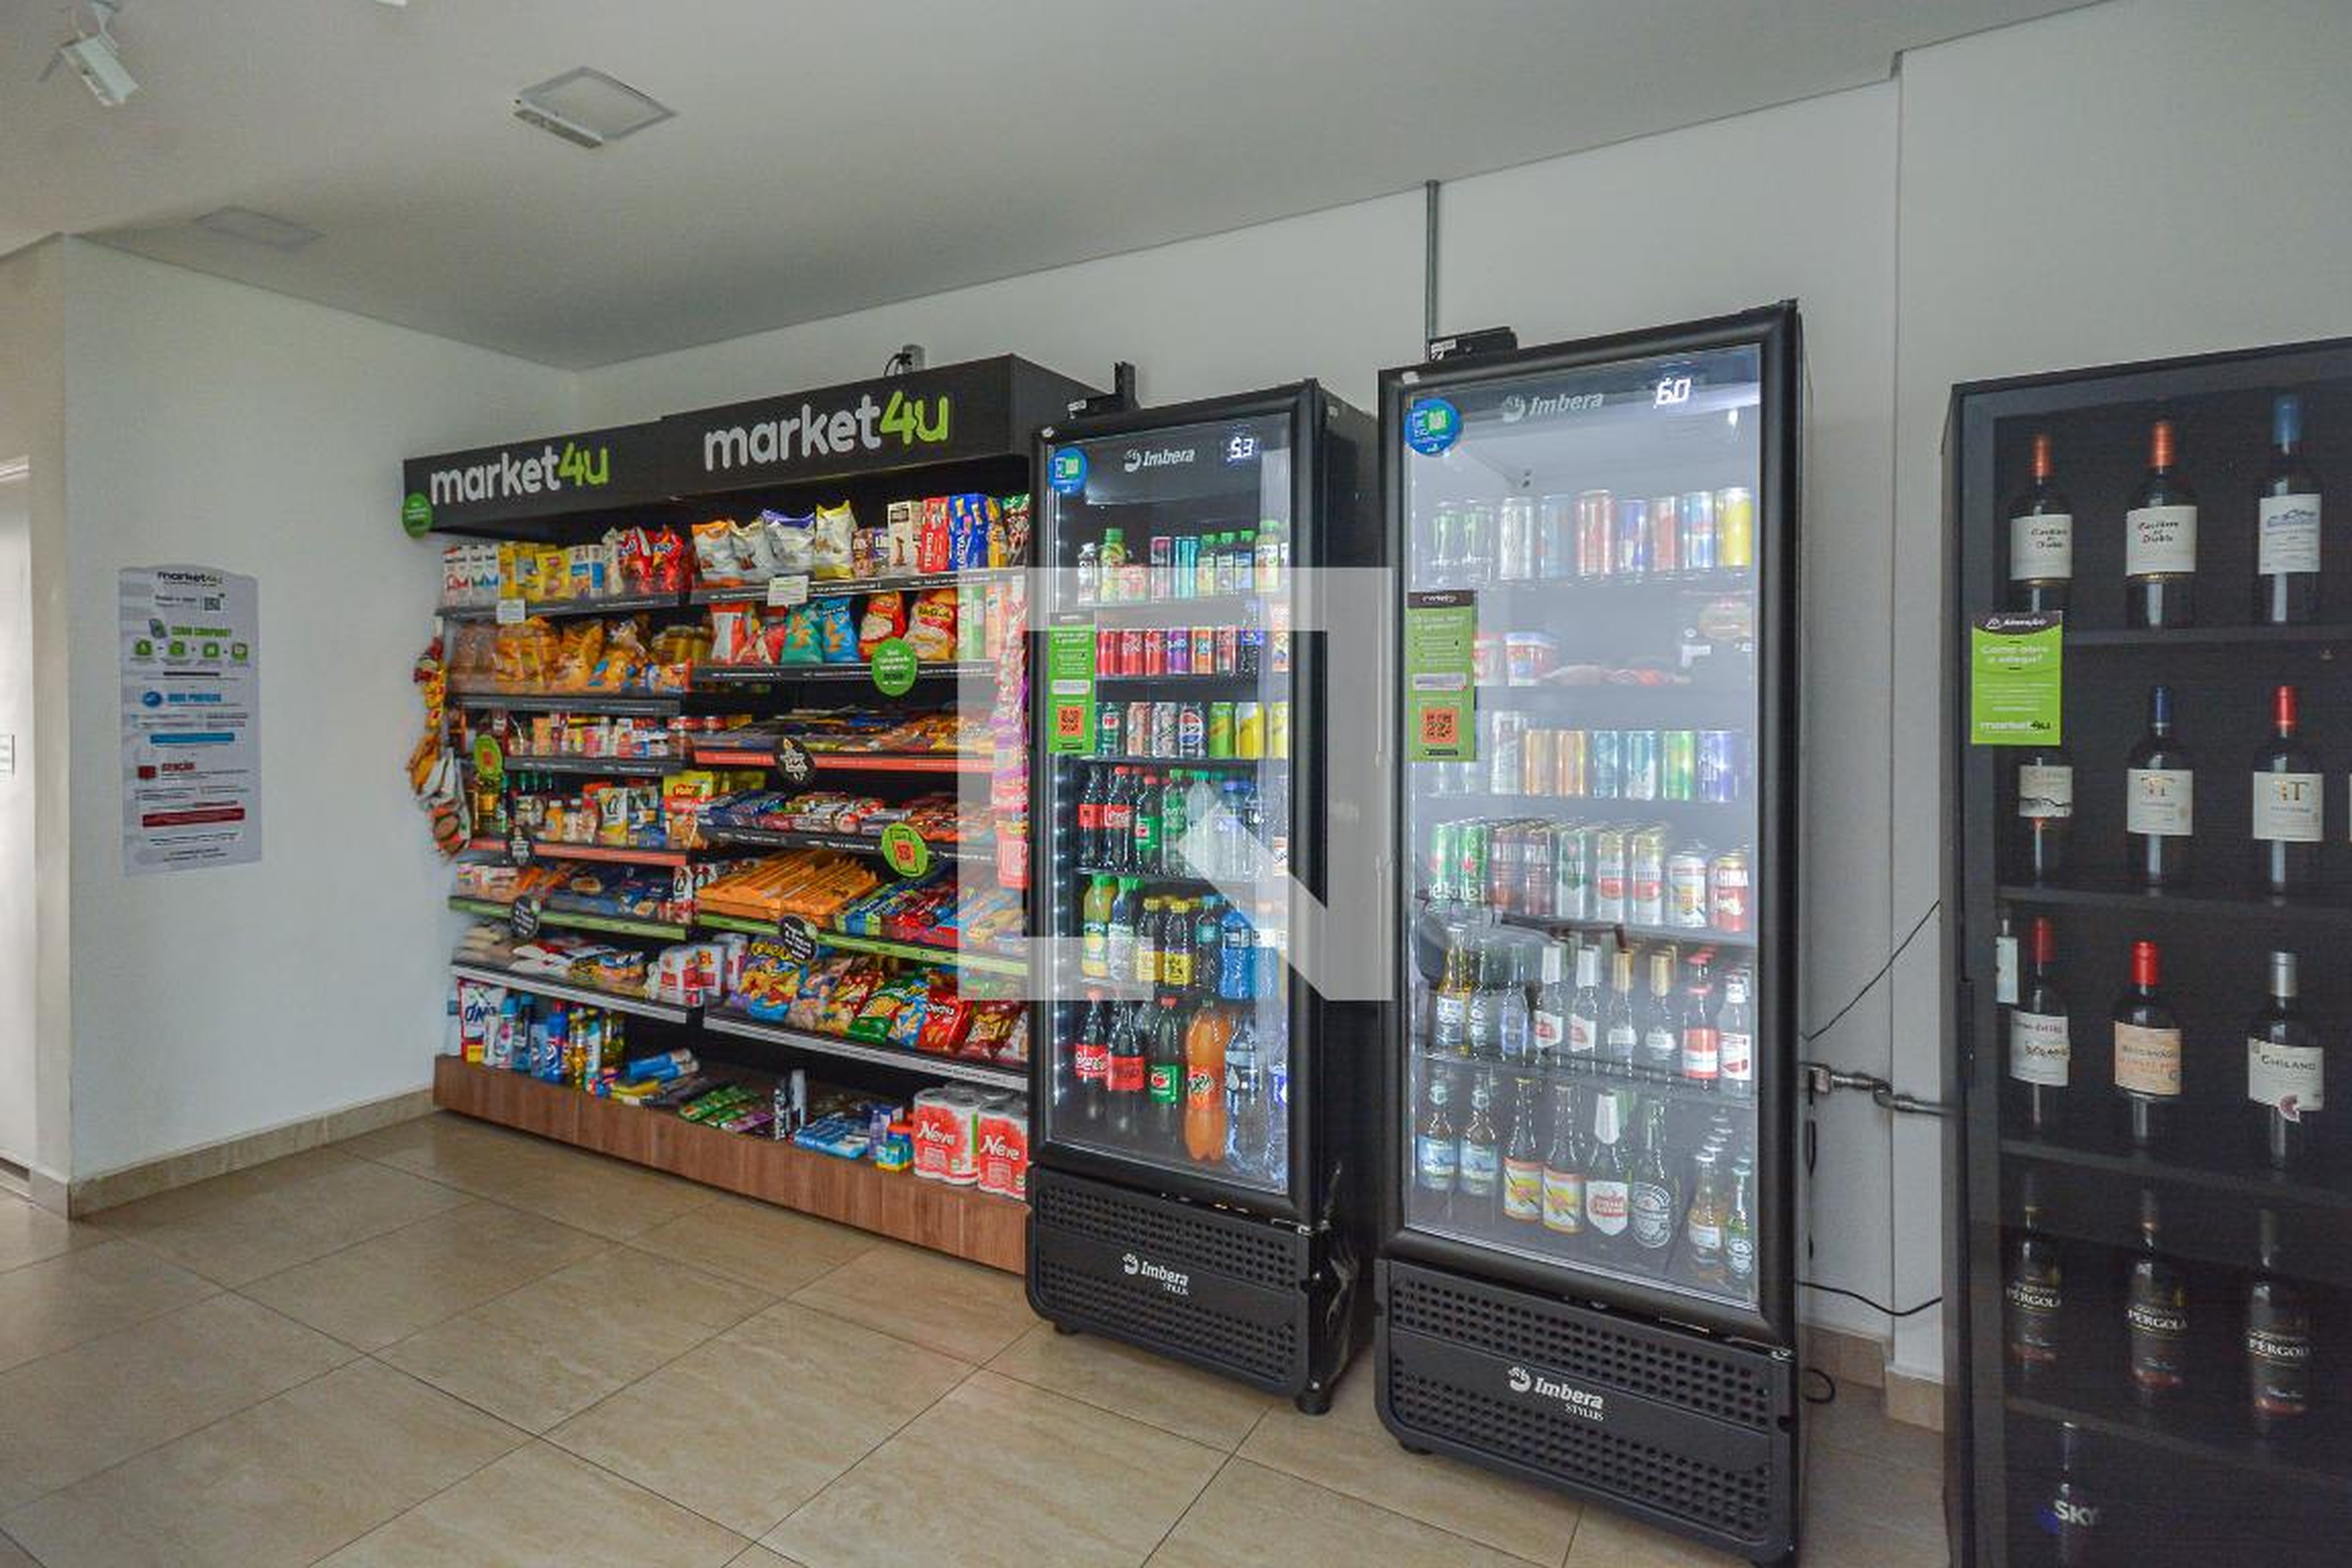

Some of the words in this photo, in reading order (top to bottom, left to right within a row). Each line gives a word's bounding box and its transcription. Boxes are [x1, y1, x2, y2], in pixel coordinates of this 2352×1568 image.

[1529, 393, 1604, 417] Imbera
[704, 390, 949, 472] market4u
[1143, 449, 1195, 467] Imbera
[431, 442, 608, 505] market4u
[1141, 1261, 1189, 1286] Imbera
[1534, 1377, 1604, 1409] Imbera
[1565, 1403, 1604, 1422] STYLUS
